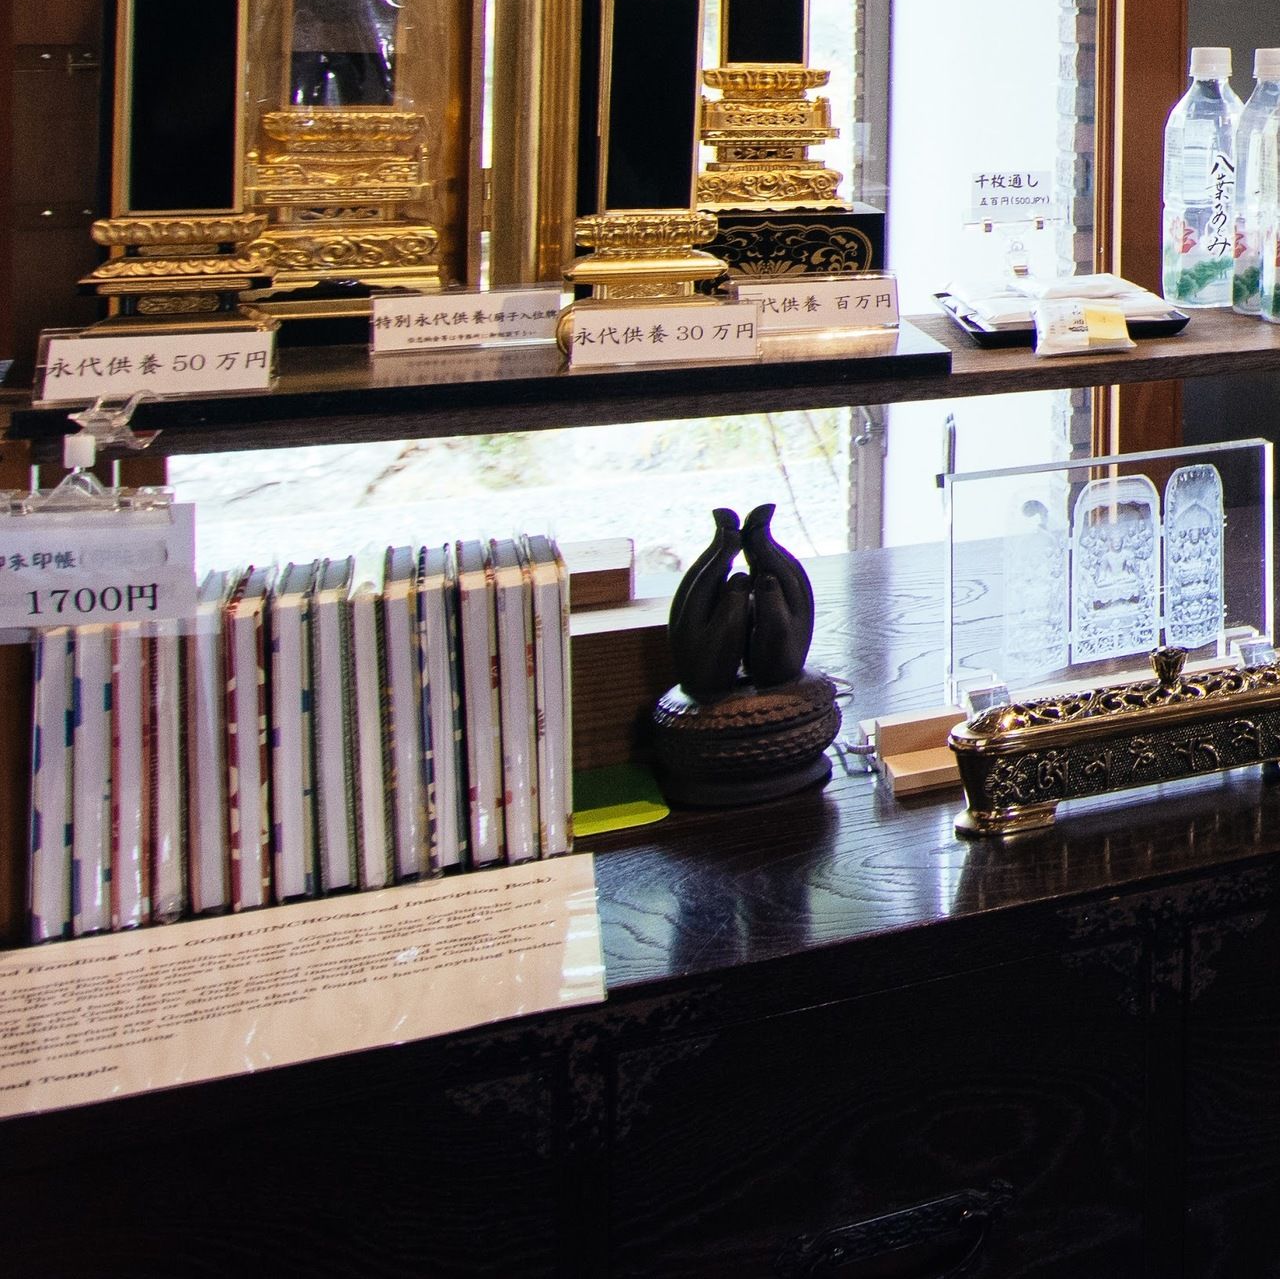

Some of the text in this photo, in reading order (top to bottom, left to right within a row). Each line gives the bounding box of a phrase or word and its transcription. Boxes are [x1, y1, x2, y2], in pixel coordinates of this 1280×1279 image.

[974, 174, 1039, 190] 千枚通し
[978, 195, 1051, 208] 五百円(500JPY)
[834, 293, 893, 312] 百万円
[573, 326, 669, 347] 永代供養
[47, 353, 163, 377] 永代供養
[27, 583, 158, 615] 1700円
